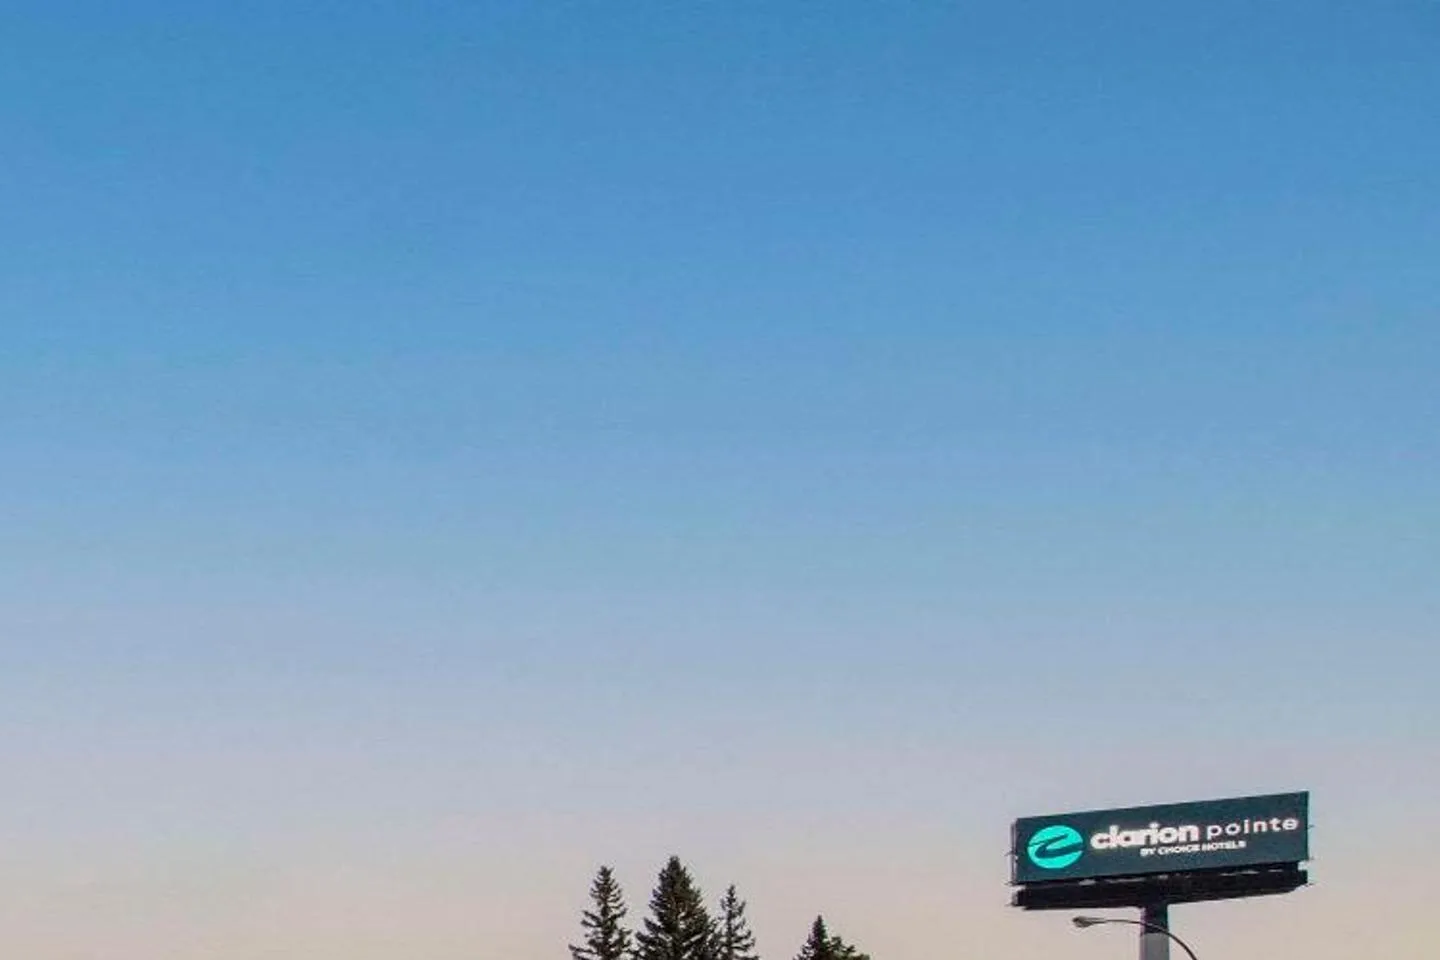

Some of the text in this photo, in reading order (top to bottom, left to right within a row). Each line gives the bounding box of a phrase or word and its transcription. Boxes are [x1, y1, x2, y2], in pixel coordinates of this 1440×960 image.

[1090, 817, 1299, 849] clarion pointe
[1140, 840, 1246, 857] BY CHOICE HOTELS
